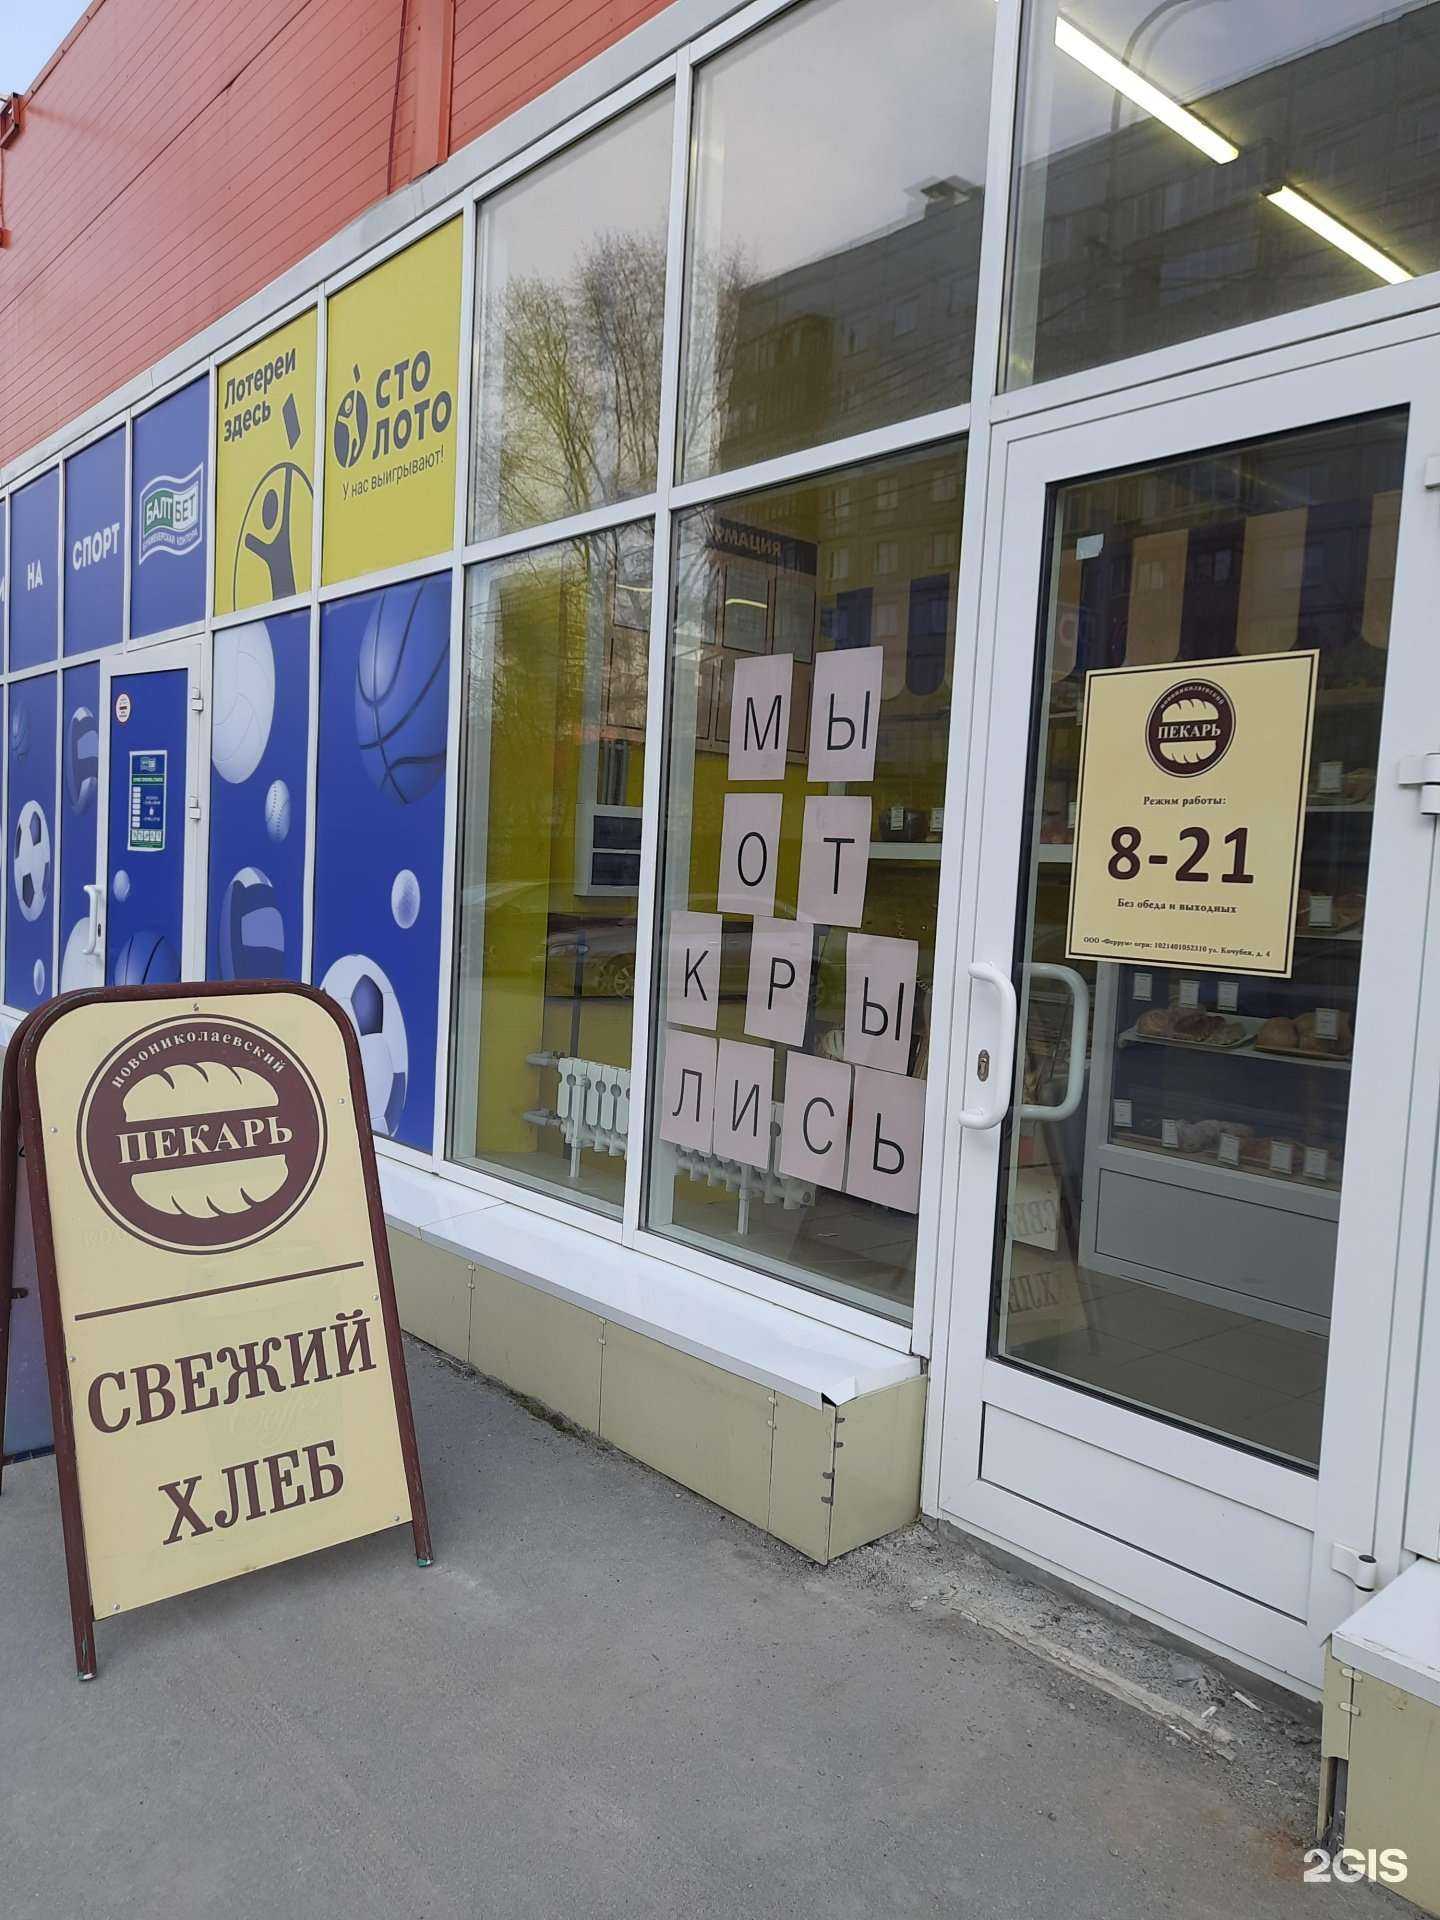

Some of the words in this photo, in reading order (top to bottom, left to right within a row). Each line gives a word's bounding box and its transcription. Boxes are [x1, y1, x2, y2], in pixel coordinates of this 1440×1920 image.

[224, 348, 296, 410] Лотереи
[375, 350, 431, 409] СТО
[223, 400, 271, 442] здесь
[372, 390, 452, 461] ЛОТО
[342, 481, 349, 501] У
[351, 479, 369, 498] нас
[371, 445, 445, 489] выигрывают!
[72, 521, 120, 571] СПОРТ
[27, 559, 43, 593] НА
[1158, 723, 1221, 739] ПЕКАРЬ
[1143, 796, 1179, 806] Режим
[1182, 795, 1227, 807] работы:
[1107, 826, 1254, 884] 8-21
[1117, 898, 1134, 908] Без
[1136, 899, 1166, 911] обеда
[1179, 904, 1238, 914] выходных
[110, 1030, 289, 1090] новониколаевский
[116, 1115, 293, 1164] ПЕКАРЬ
[87, 1309, 377, 1434] СВЕЖИЙ
[158, 1439, 346, 1546] ХЛЕБ
